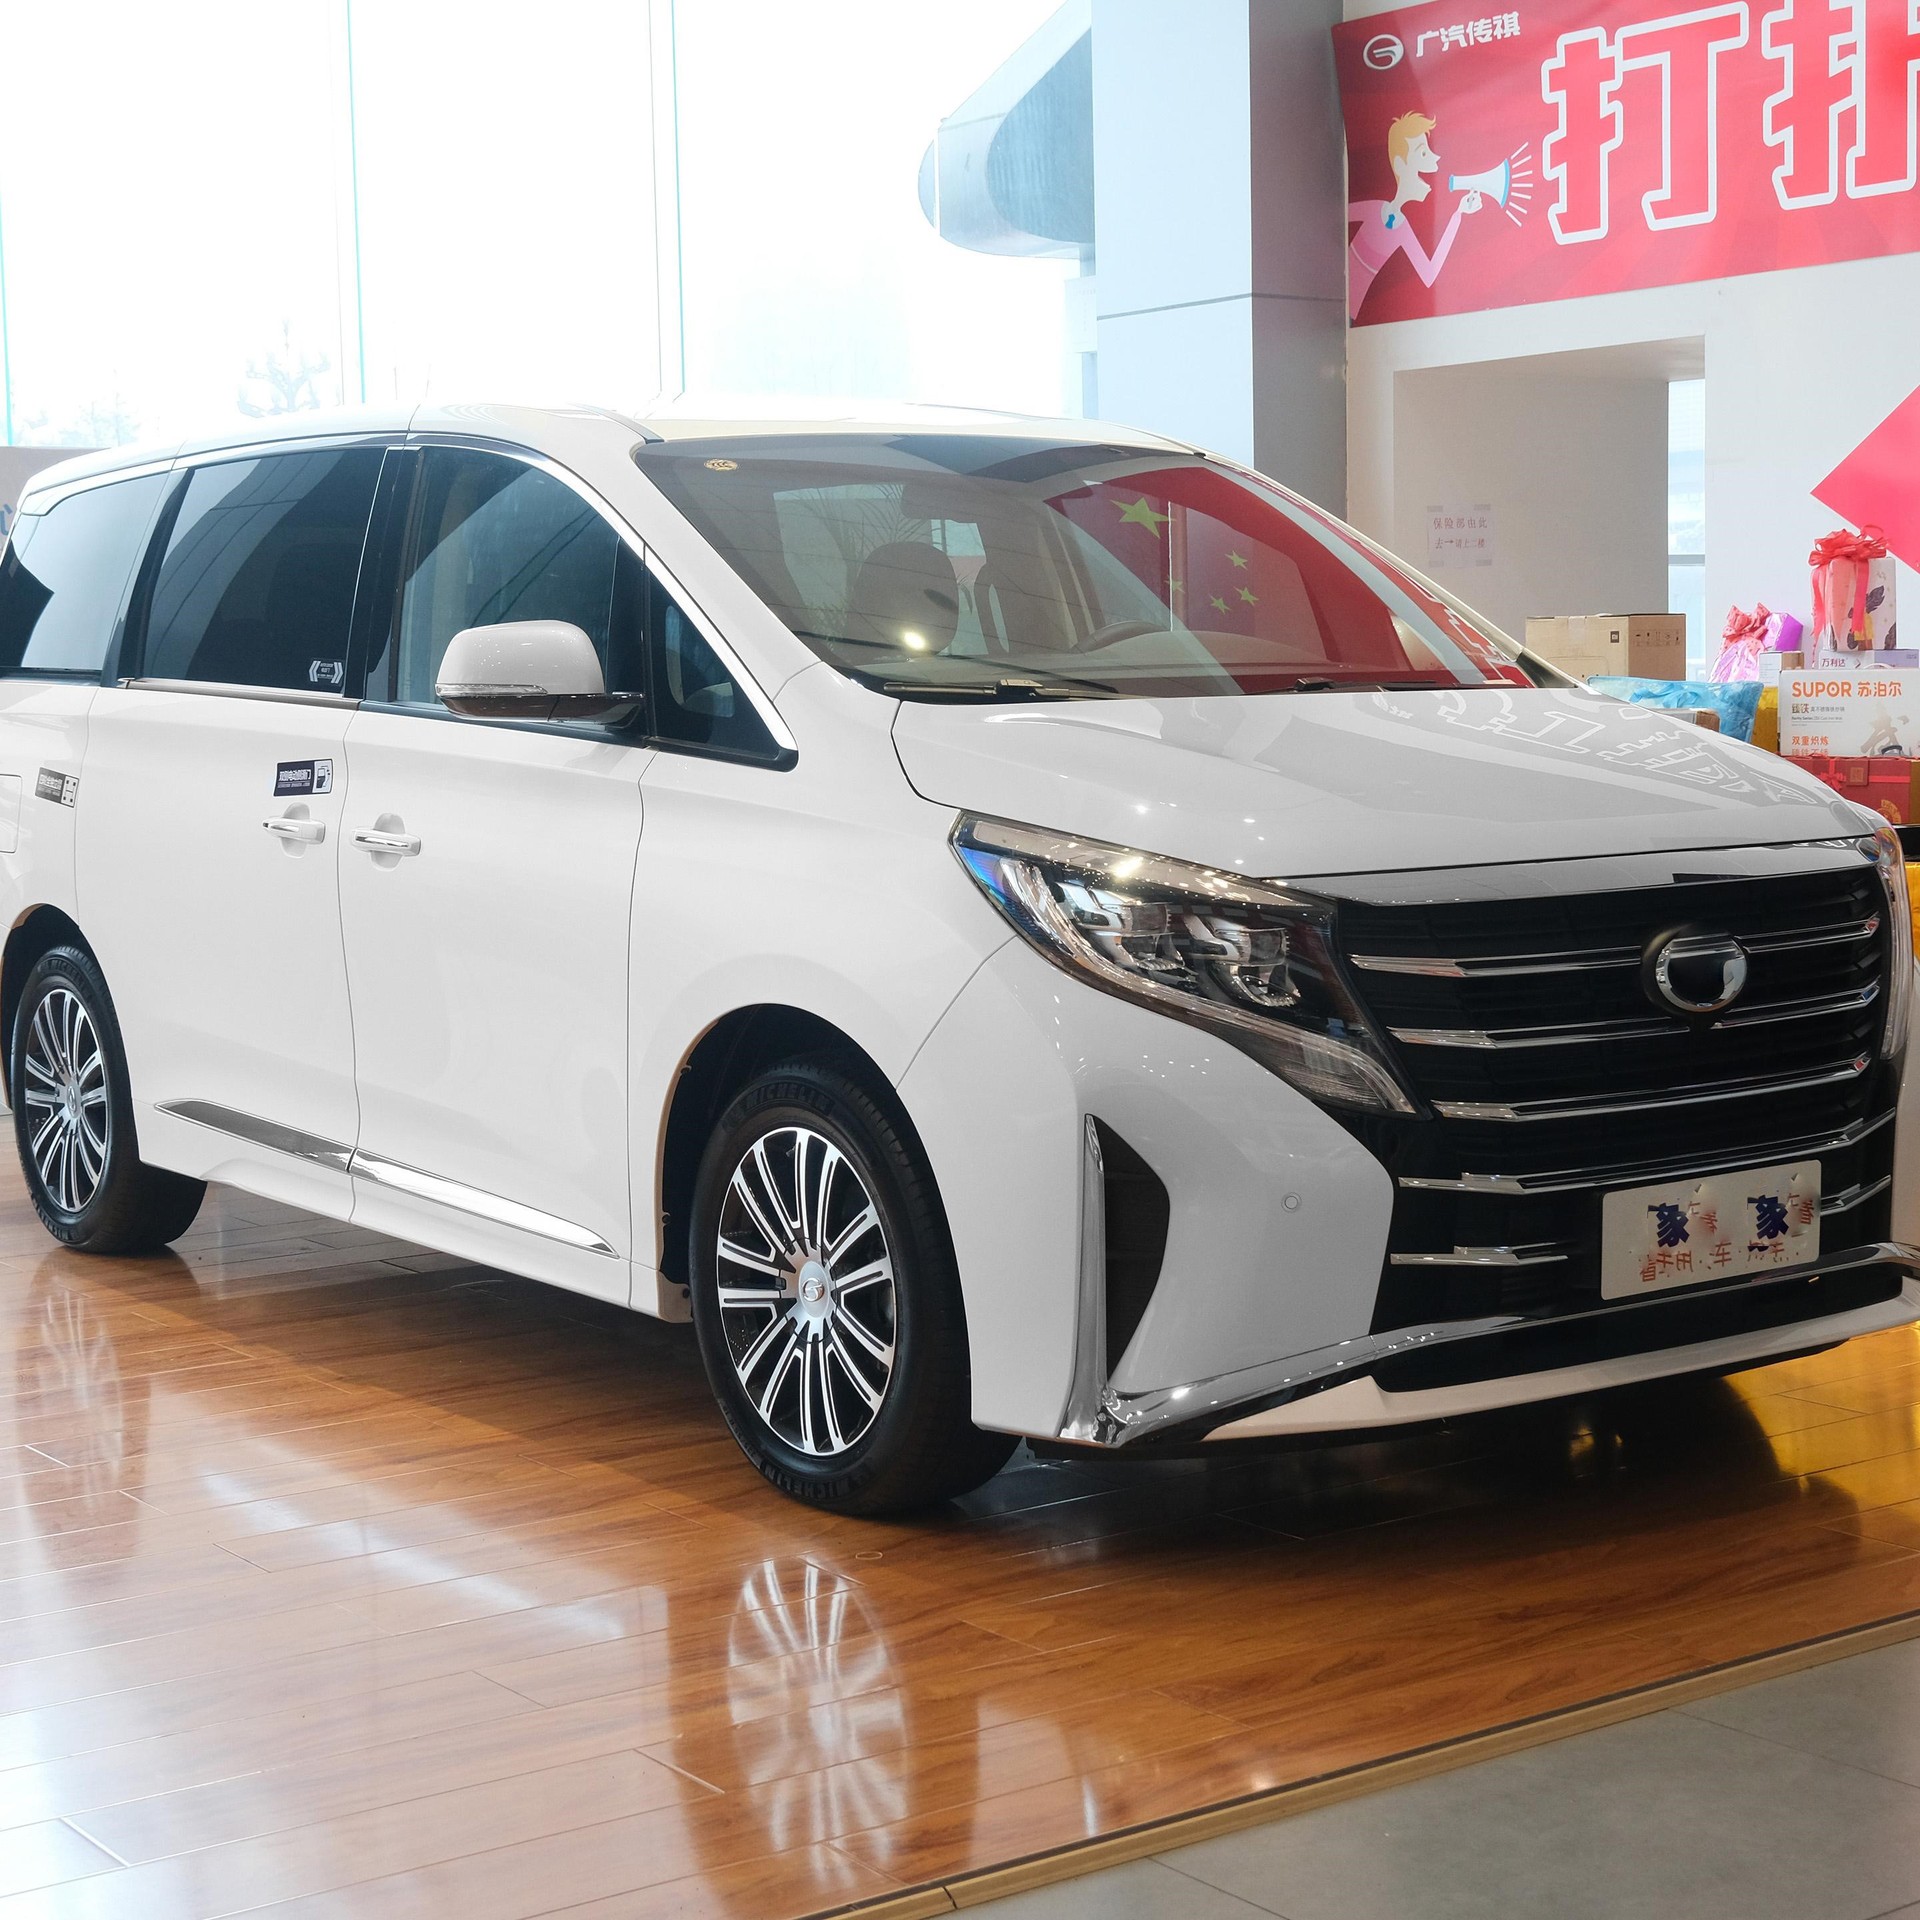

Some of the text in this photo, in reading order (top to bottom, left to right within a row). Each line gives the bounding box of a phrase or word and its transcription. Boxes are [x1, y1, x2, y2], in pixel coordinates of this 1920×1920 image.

[1416, 11, 1520, 57] 广汽传祺
[1822, 658, 1846, 667] 万利达
[1792, 681, 1902, 697] SUPOR 苏泊尔
